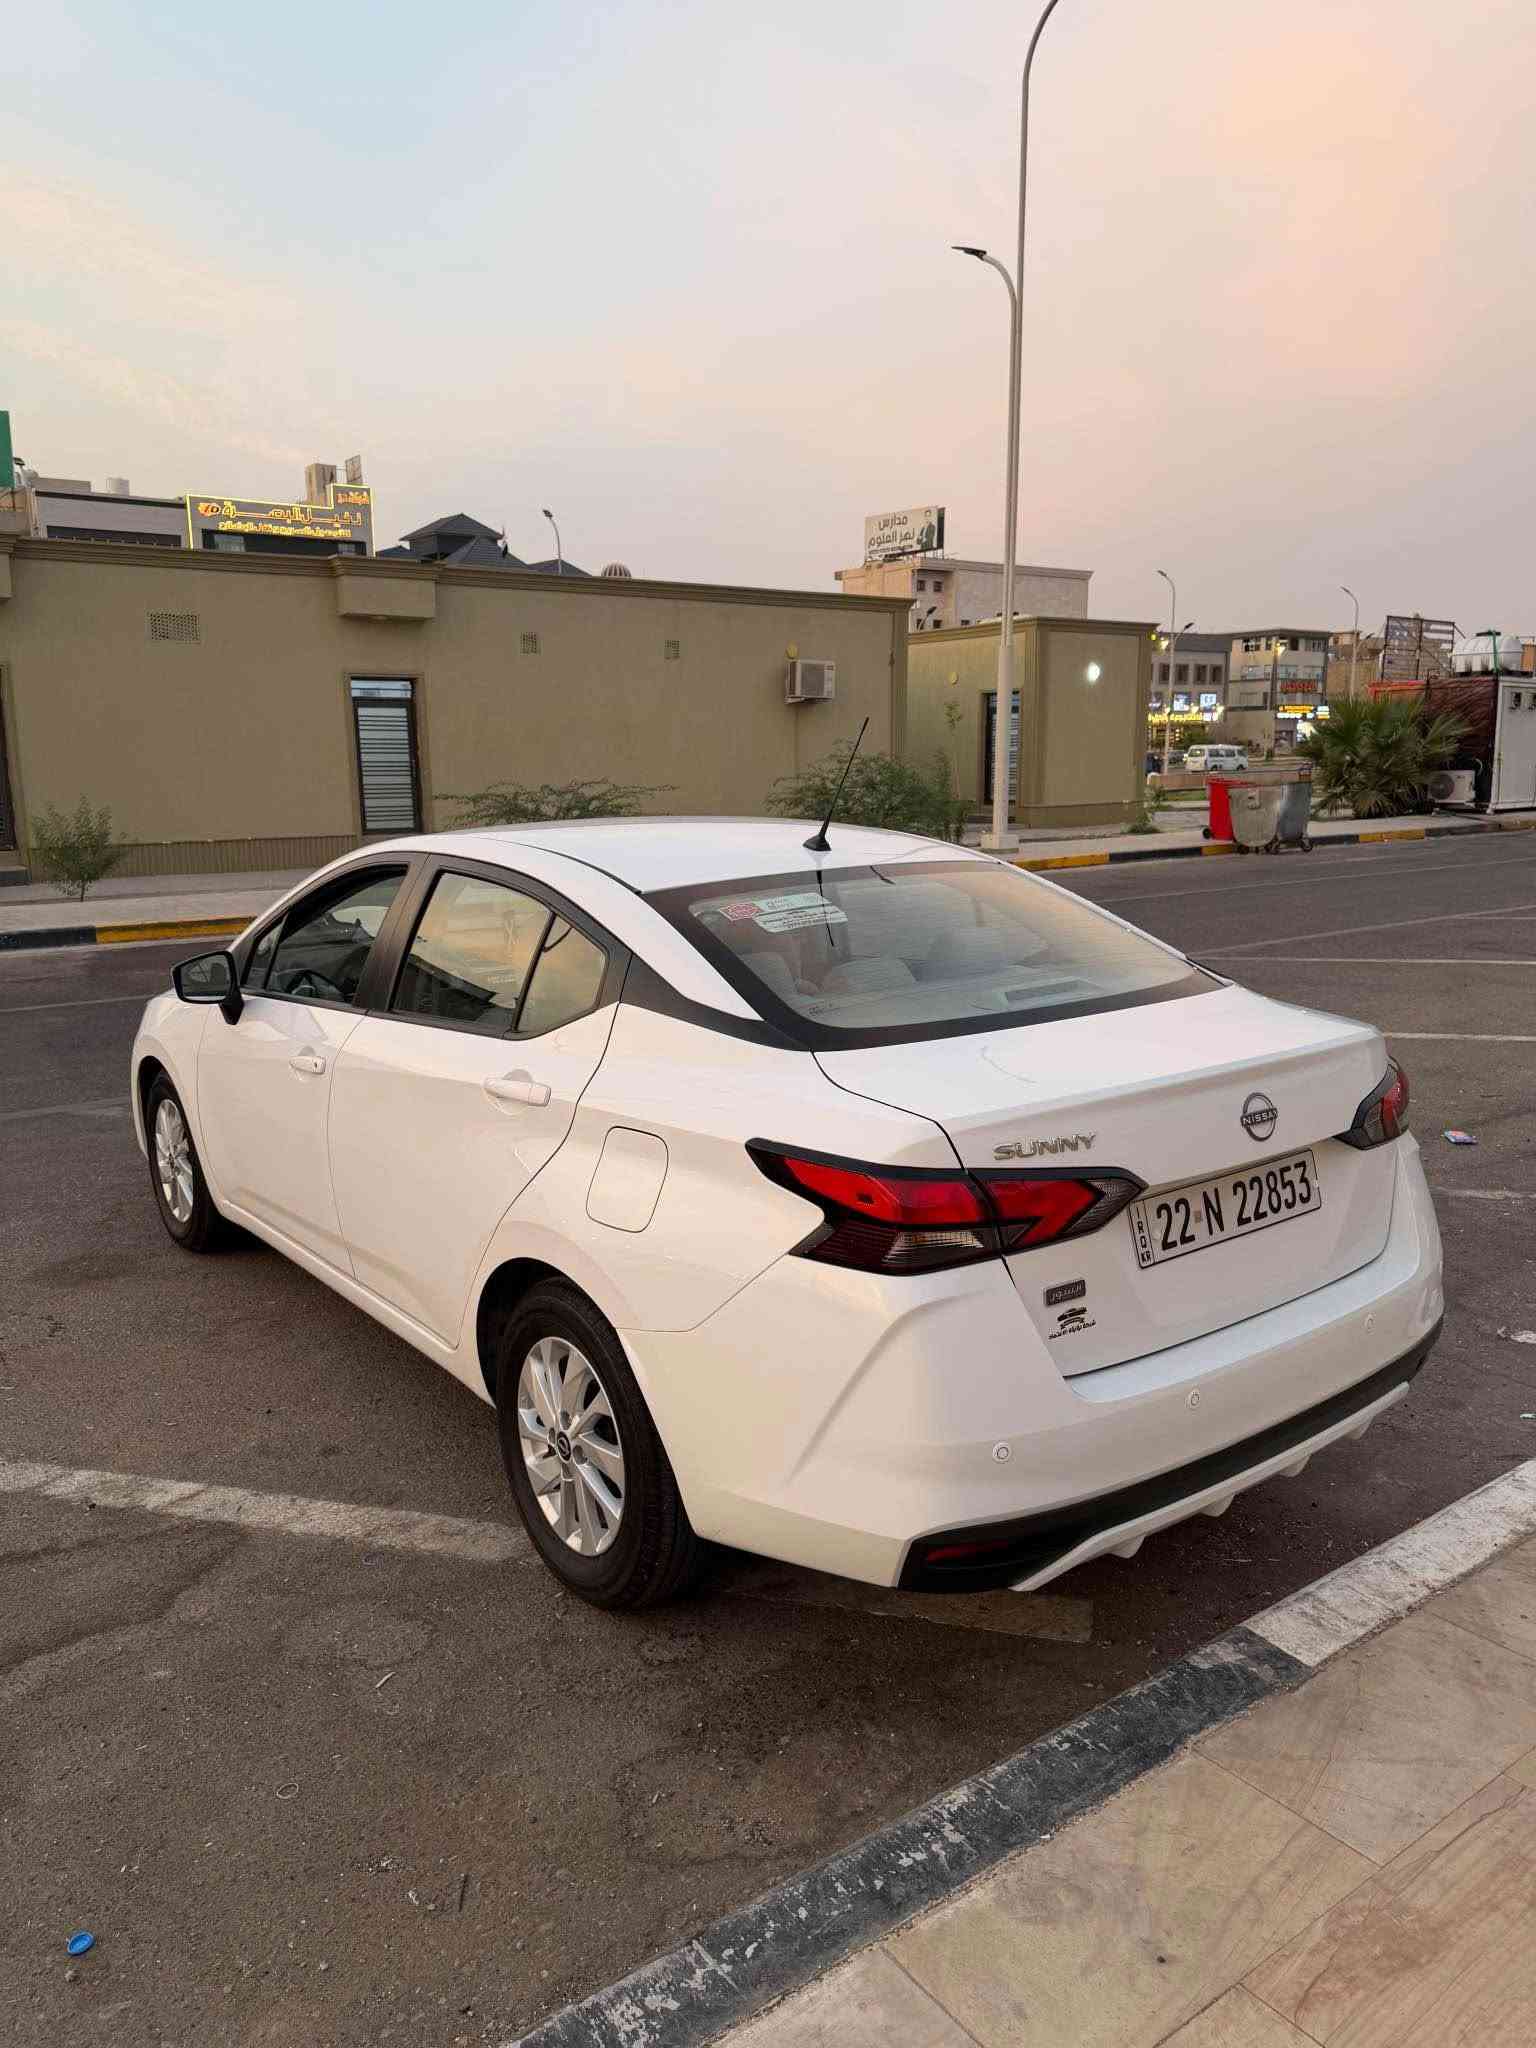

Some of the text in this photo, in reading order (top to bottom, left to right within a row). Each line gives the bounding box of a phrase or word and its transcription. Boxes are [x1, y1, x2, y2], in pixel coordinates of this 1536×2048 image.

[878, 512, 908, 531] مدارس
[993, 1133, 1096, 1161] SUNNY
[1156, 1160, 1312, 1251] 22 N 22853
